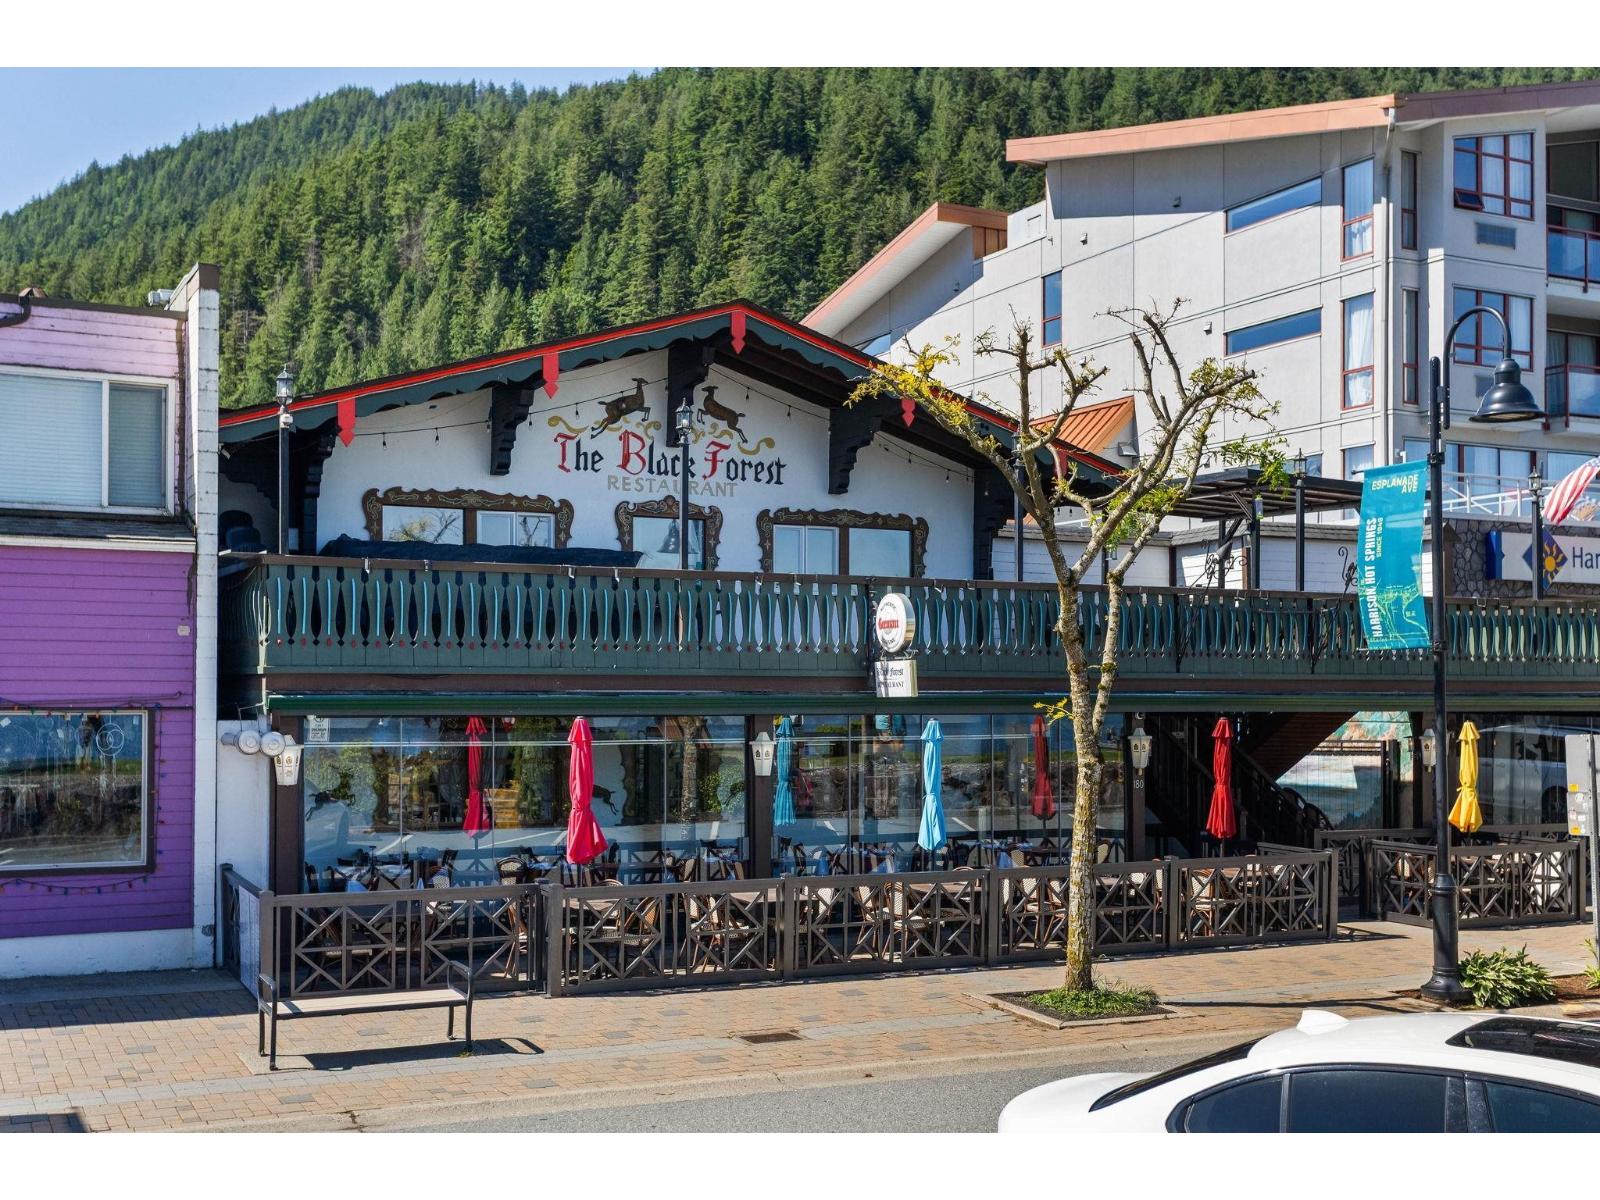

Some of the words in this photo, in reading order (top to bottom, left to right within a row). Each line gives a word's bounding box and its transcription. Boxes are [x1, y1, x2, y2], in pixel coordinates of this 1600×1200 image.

[554, 431, 604, 473] The
[616, 429, 696, 478] Black
[702, 440, 788, 485] Forest
[607, 474, 738, 497] RESTAURANT
[1371, 473, 1419, 491] ESPLANADE
[1401, 483, 1418, 494] AVE
[1364, 518, 1377, 561] SPRINGS
[1364, 564, 1377, 585] HOT
[1366, 587, 1384, 638] HARRISON
